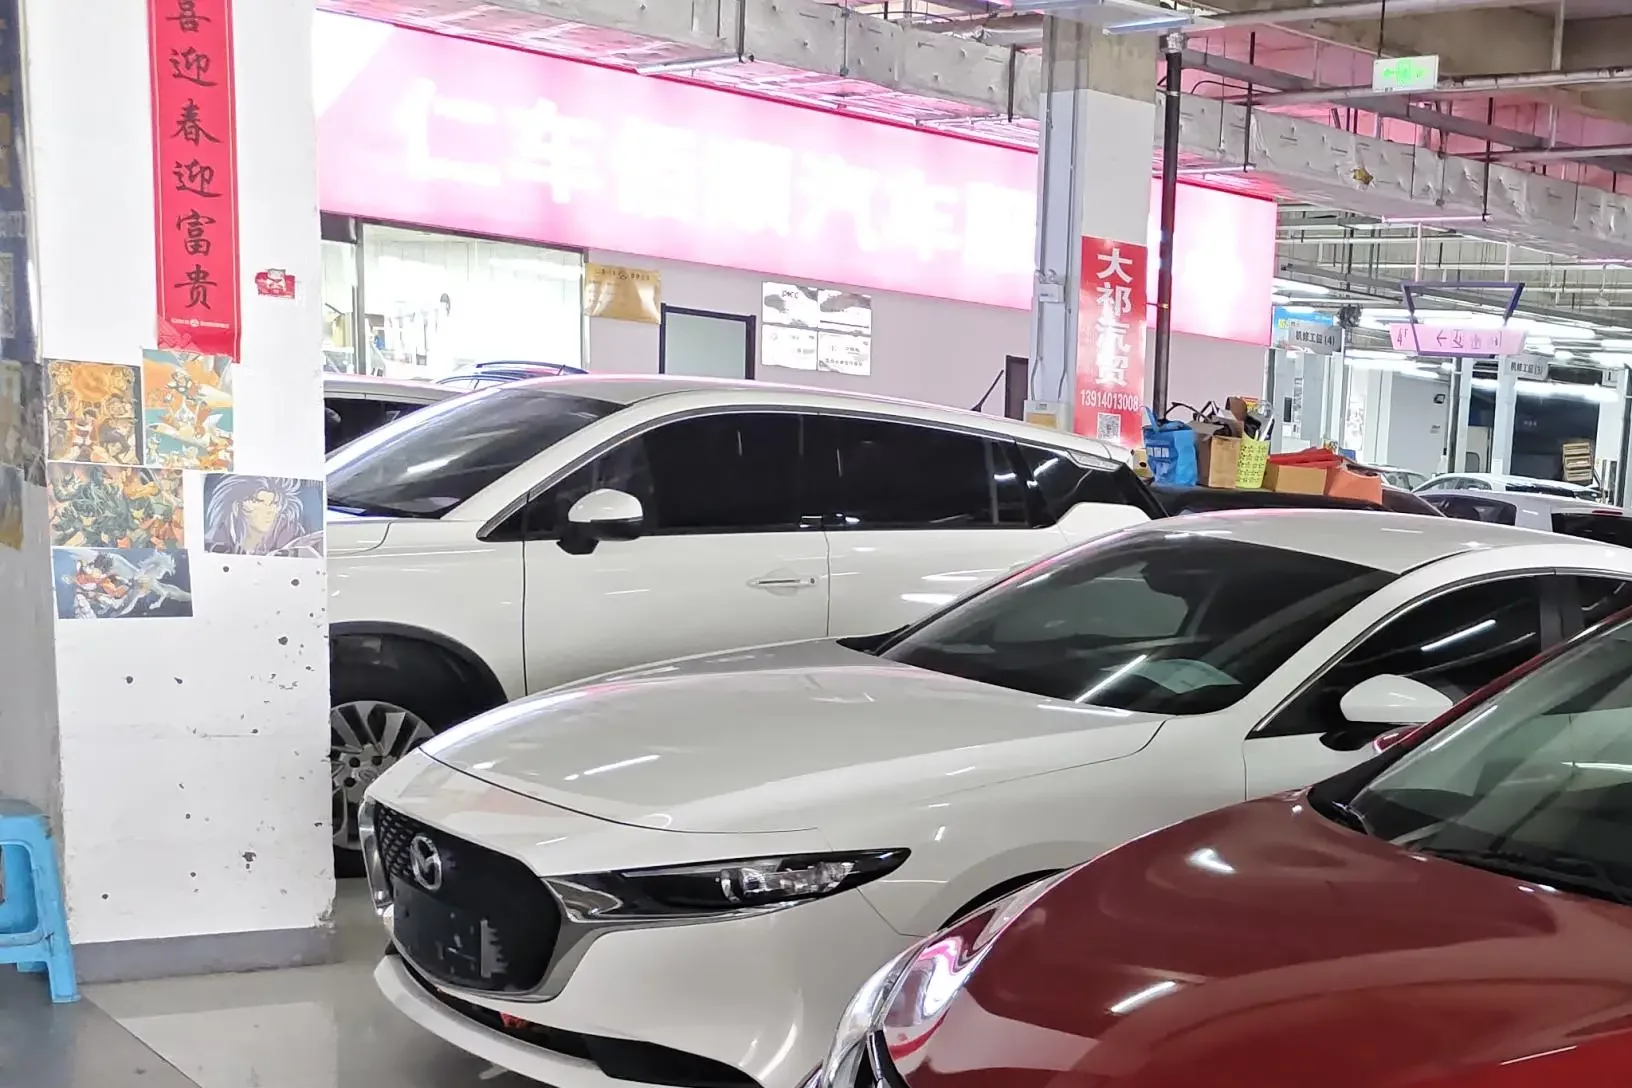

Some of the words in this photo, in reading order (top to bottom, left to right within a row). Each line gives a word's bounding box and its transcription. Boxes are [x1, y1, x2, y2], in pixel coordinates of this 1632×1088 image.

[1096, 247, 1134, 387] 大祁汽贸
[1080, 389, 1140, 412] 13914013008
